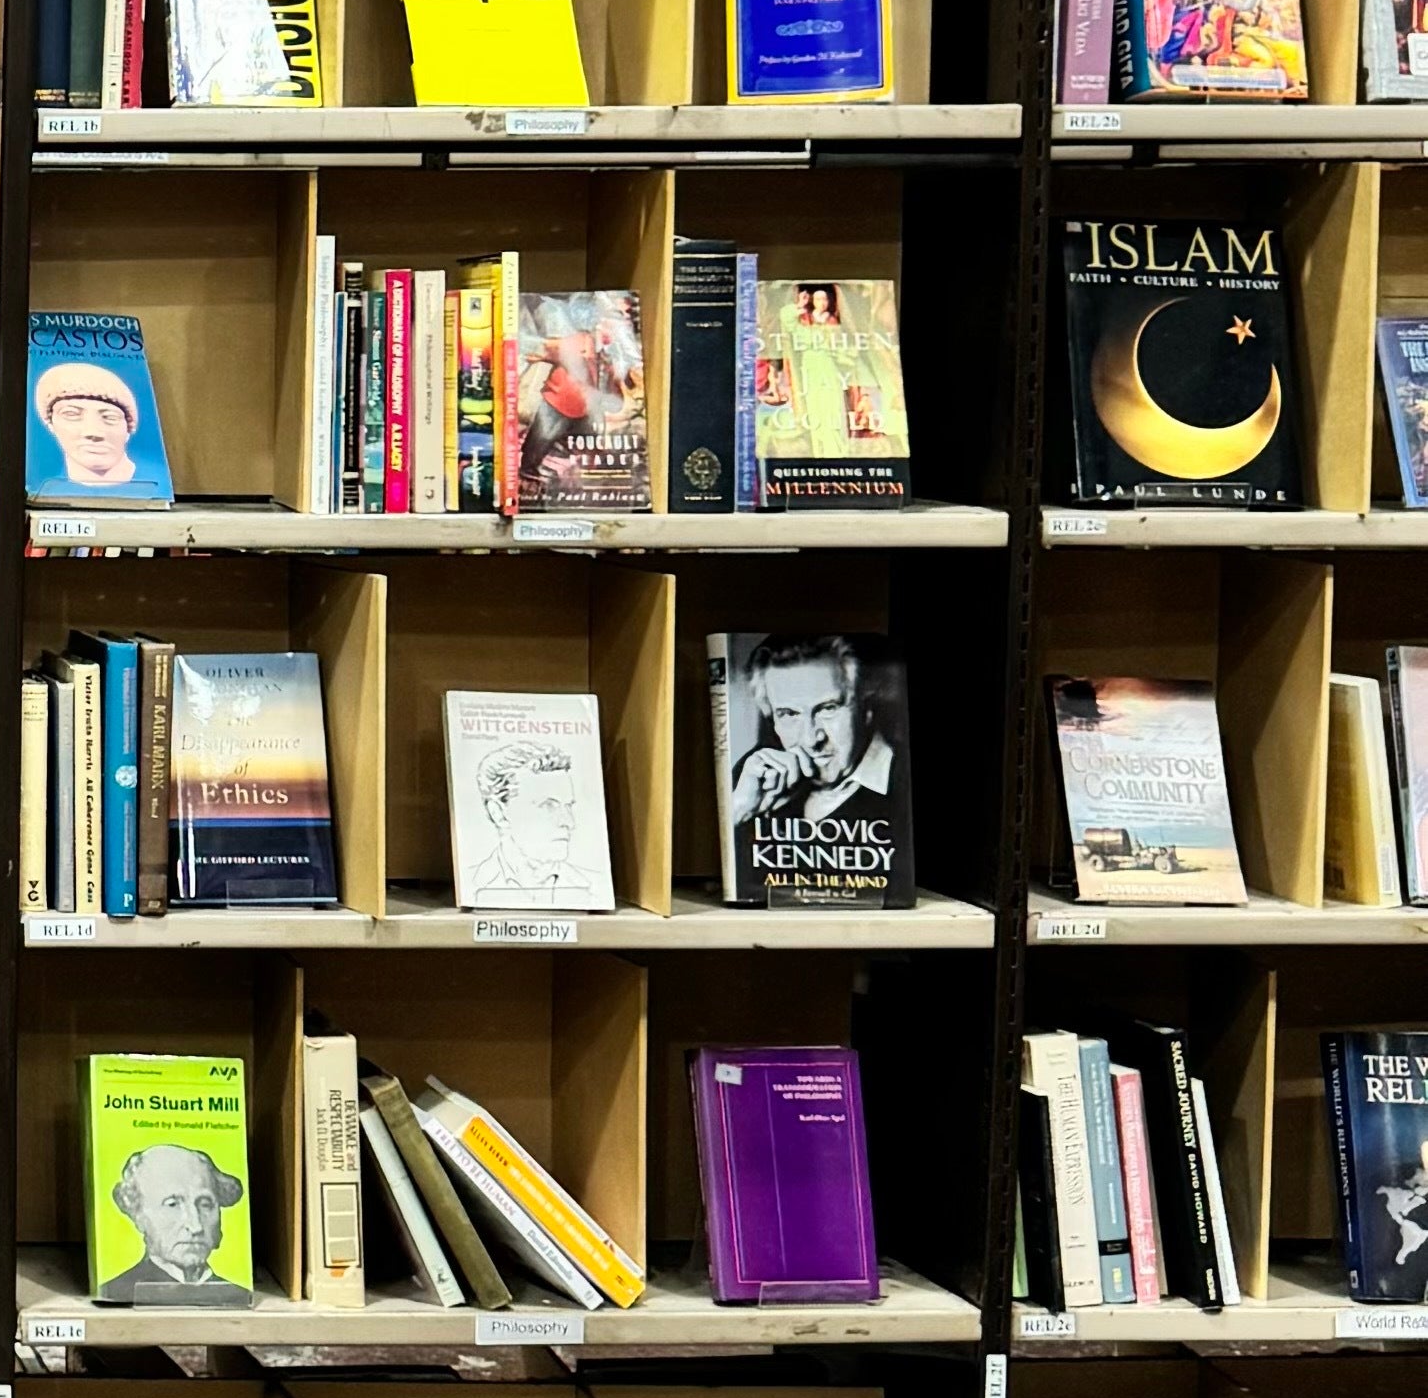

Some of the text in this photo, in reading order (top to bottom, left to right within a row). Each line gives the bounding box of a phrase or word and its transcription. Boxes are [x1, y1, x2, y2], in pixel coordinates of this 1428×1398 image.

[1084, 221, 1278, 274] ISLAM
[1070, 272, 1281, 290] FAITH CULTURE HISTORY
[45, 315, 139, 332] MURDOCH
[753, 328, 893, 352] STEPHEN
[774, 468, 893, 477] QUESTIONING THE
[766, 482, 904, 495] MILLENNIUM
[460, 718, 592, 736] WITTGENSTEIN
[1068, 747, 1216, 781] CORNERSTONE
[201, 782, 289, 804] Ethics
[1085, 777, 1207, 802] COMMUNITY
[754, 817, 892, 844] LUDOVIC
[751, 844, 896, 872] KENNEDY
[44, 924, 92, 936] REL 1d
[476, 921, 570, 942] Philosophy
[1363, 1055, 1409, 1076] THE
[103, 1094, 239, 1112] John Stuart Mill
[490, 1320, 569, 1337] Philosophy
[1356, 1316, 1397, 1329] World
